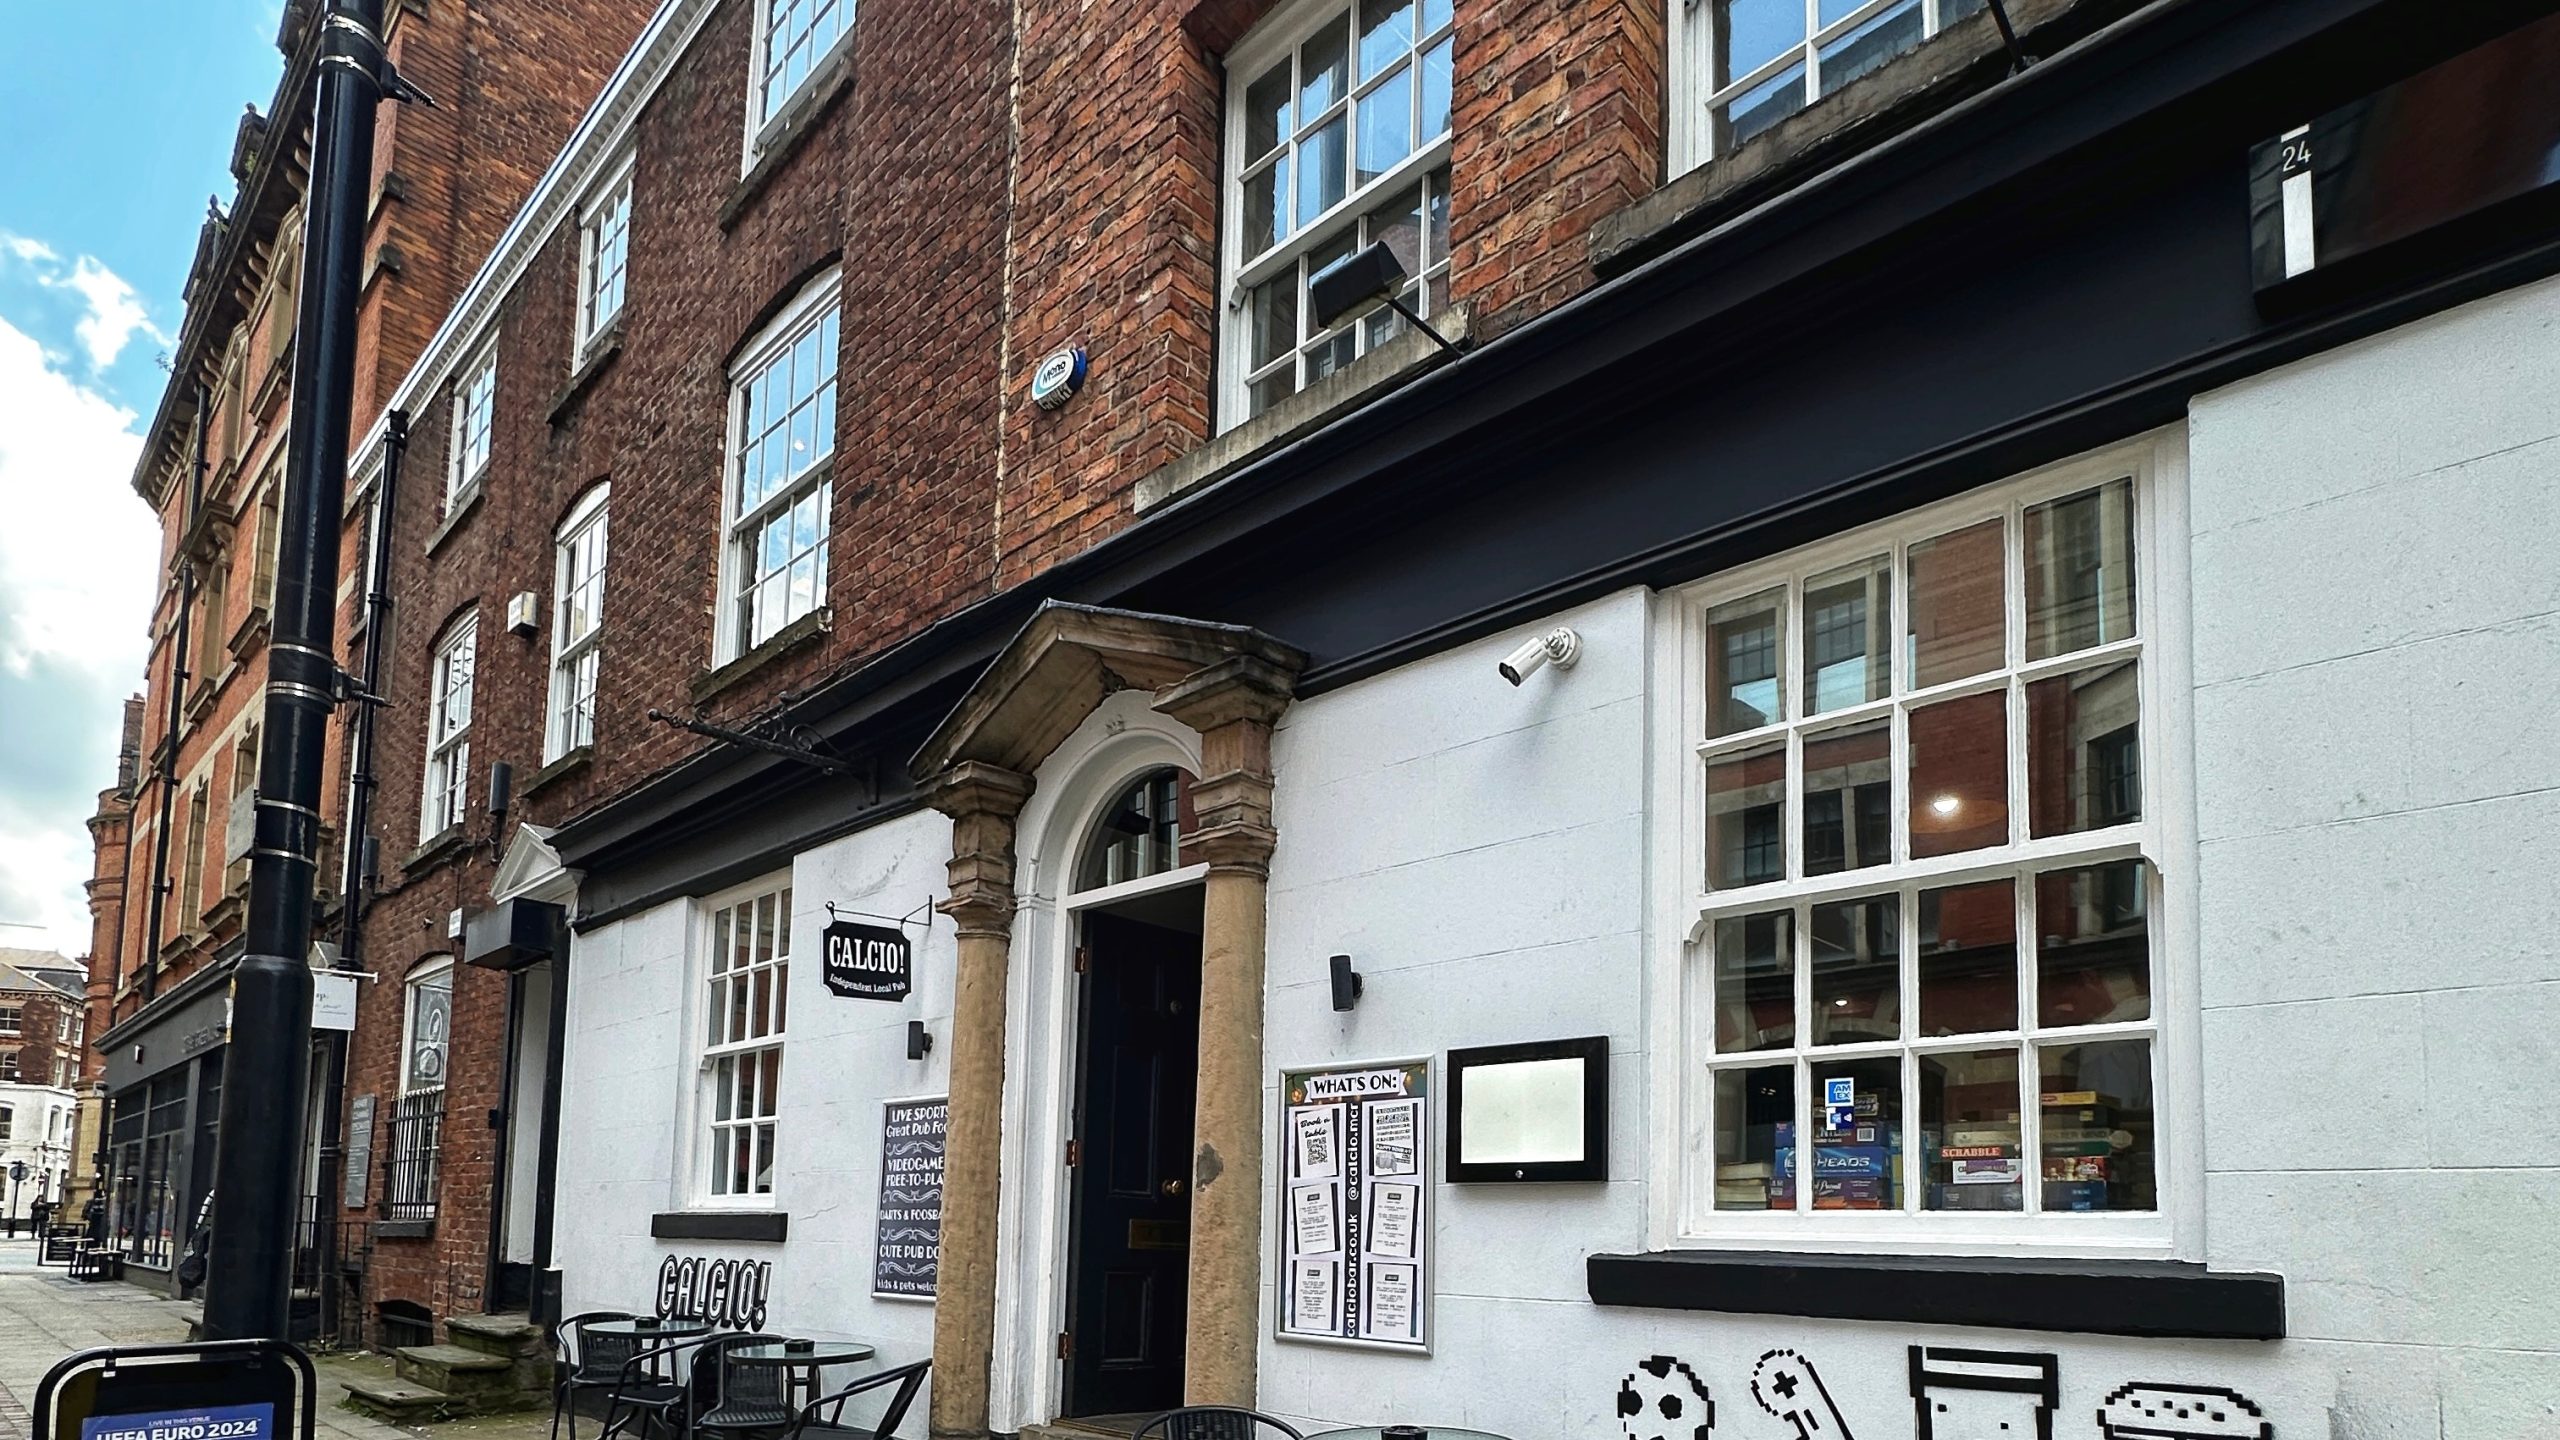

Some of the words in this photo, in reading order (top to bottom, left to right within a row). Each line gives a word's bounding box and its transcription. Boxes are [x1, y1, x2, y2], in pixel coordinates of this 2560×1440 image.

[2282, 140, 2313, 172] 24
[829, 935, 905, 975] CALCIO!
[829, 973, 873, 992] Independent
[874, 983, 892, 993] Local
[892, 981, 906, 991] Pub
[1313, 1076, 1366, 1094] WHAT'S
[1370, 1074, 1397, 1090] ON:
[892, 1108, 913, 1122] LIVE
[1300, 1116, 1322, 1128] Book
[886, 1124, 911, 1138] Great
[912, 1122, 931, 1136] Pub
[1304, 1128, 1327, 1139] table
[1347, 1102, 1360, 1201] @calcio.mcr
[1942, 1147, 2001, 1157] SCRABBLE
[886, 1172, 945, 1187] FREE-TO-PLA
[880, 1209, 902, 1221] DARTS
[903, 1209, 909, 1220] &
[879, 1244, 902, 1259] CUTE
[904, 1245, 925, 1259] PUB
[1346, 1213, 1359, 1338] calciobar.co.uk
[877, 1278, 892, 1290] kids
[893, 1280, 898, 1290] &
[899, 1280, 916, 1292] pets
[655, 1254, 772, 1332] CALCIO!
[148, 1419, 163, 1427] LIVE
[189, 1415, 211, 1423] VENUE
[151, 1424, 205, 1440] EURO
[207, 1418, 258, 1437] 2024
